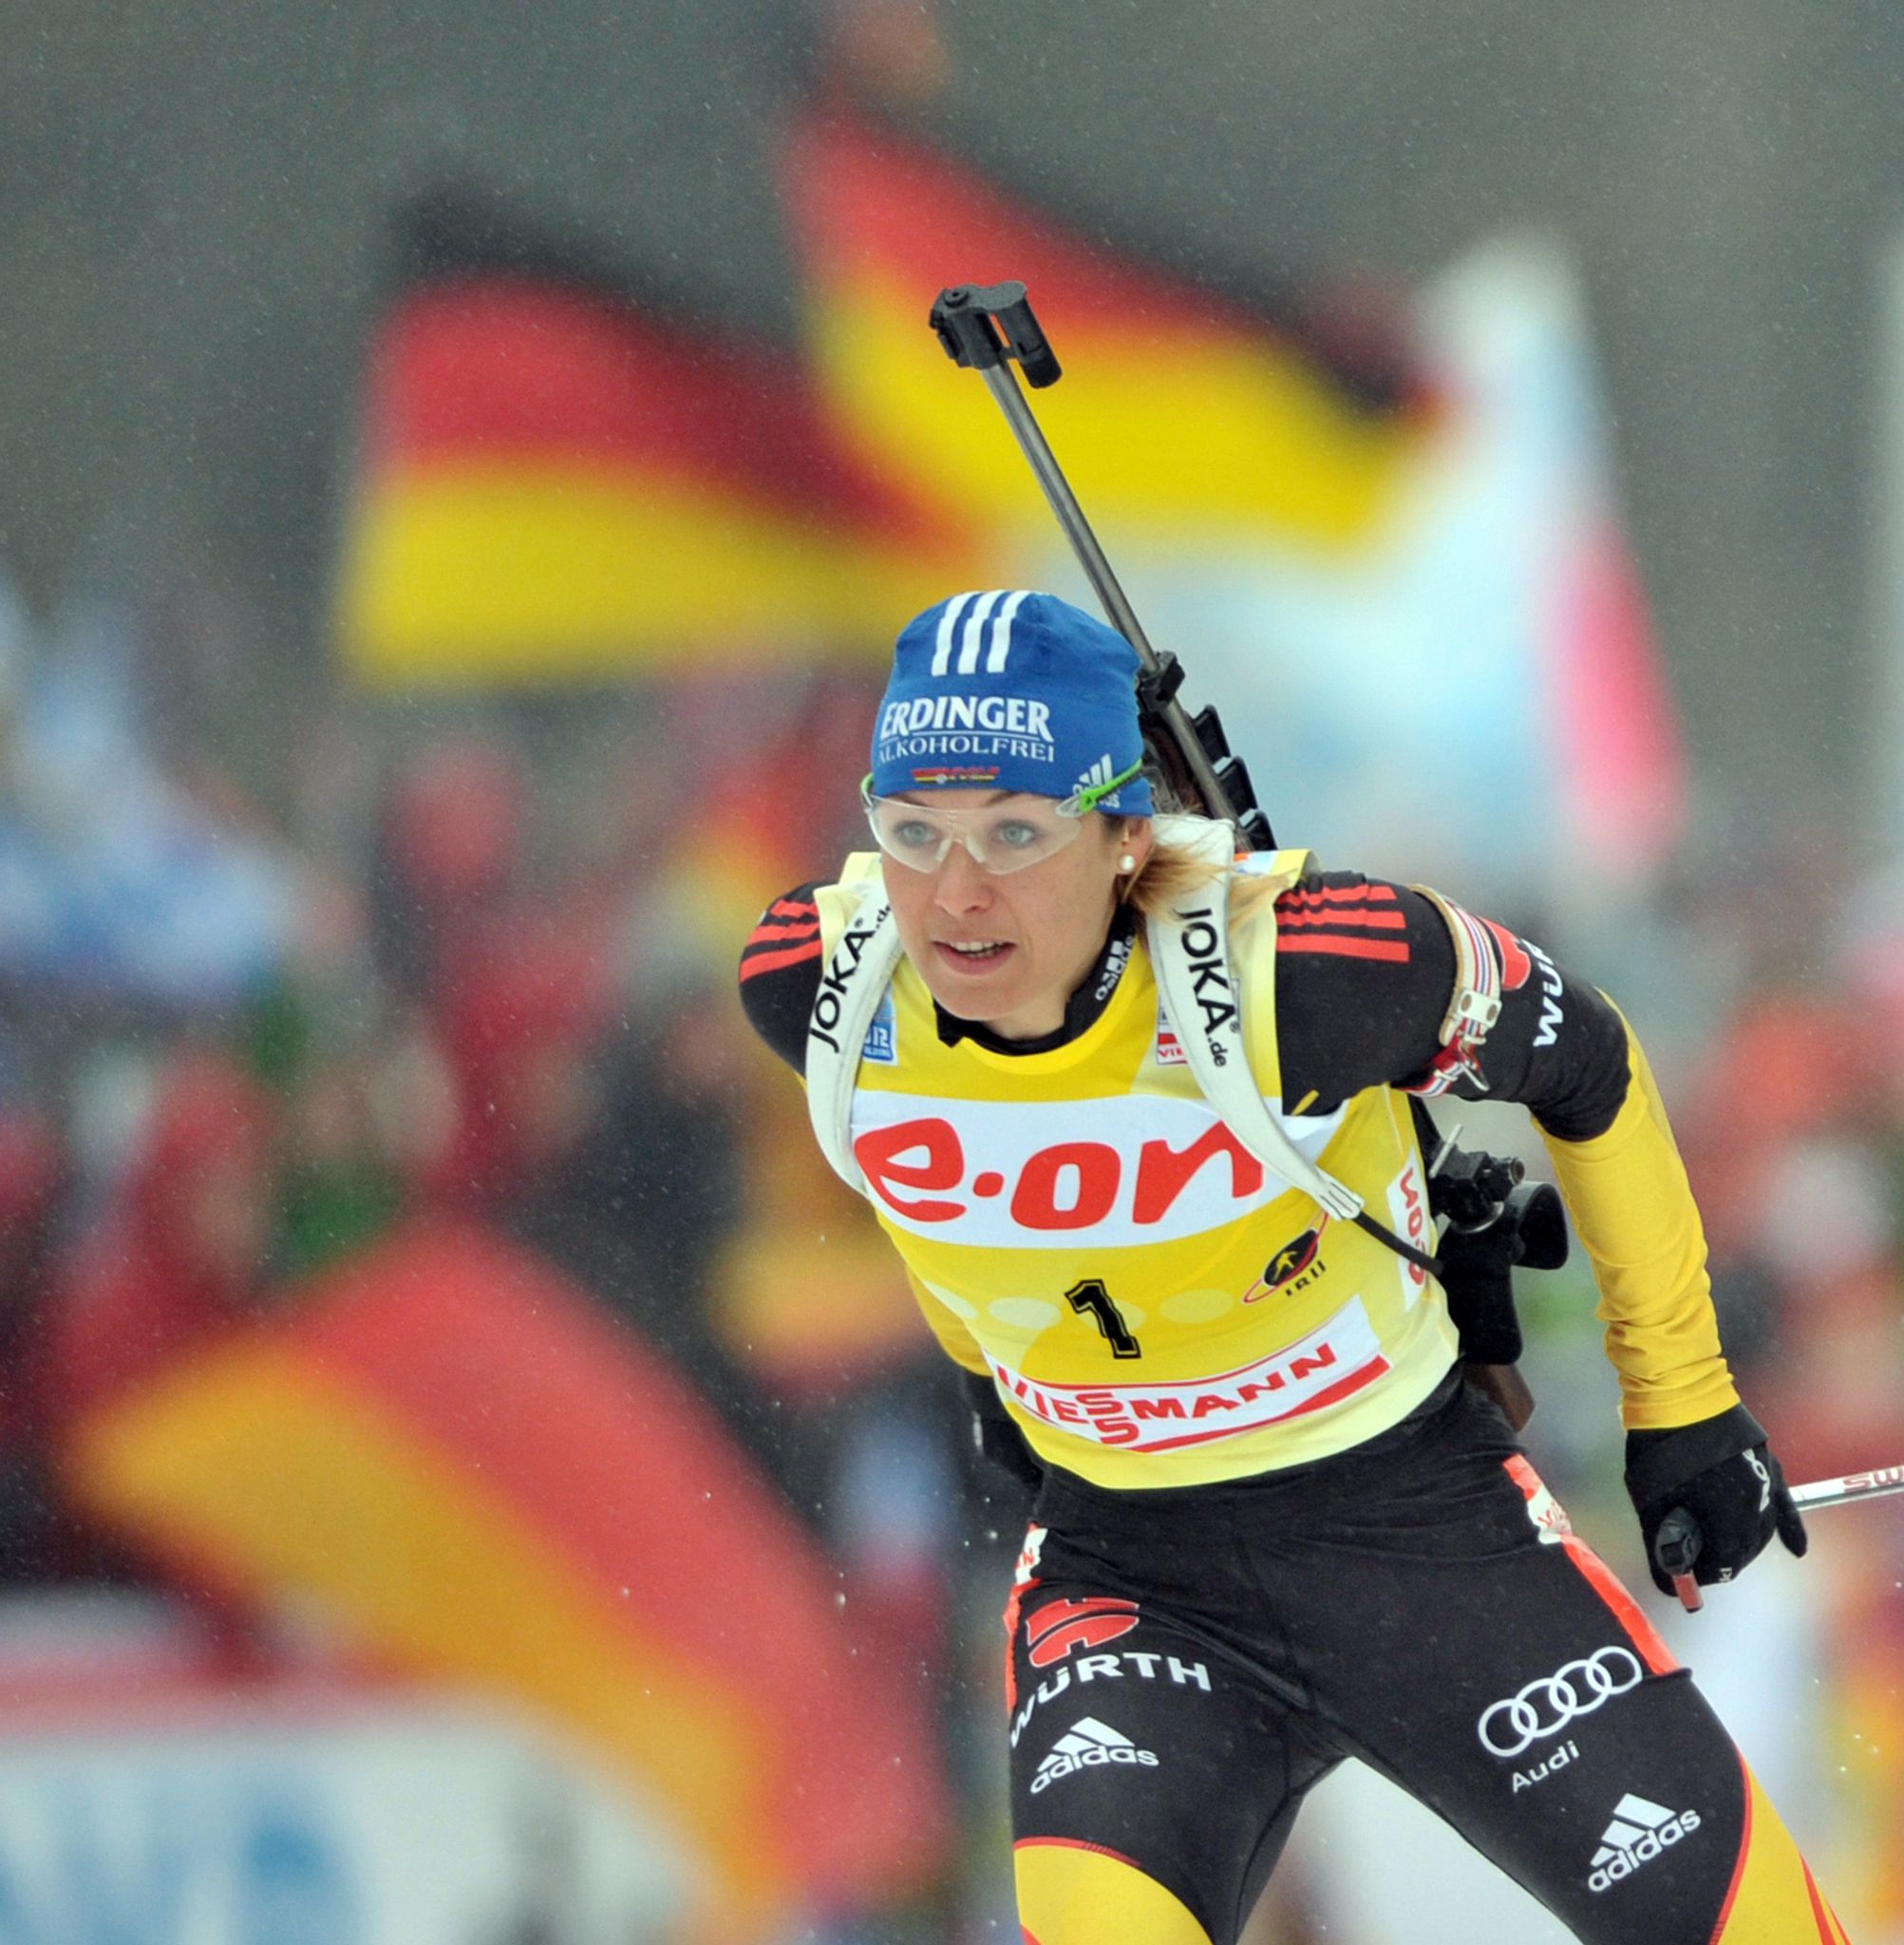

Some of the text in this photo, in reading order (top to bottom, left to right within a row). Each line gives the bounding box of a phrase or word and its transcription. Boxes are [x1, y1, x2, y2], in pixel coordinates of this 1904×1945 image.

[879, 695, 1054, 743] ERDINGER
[878, 735, 1055, 763] ALKOHOLFREI
[1065, 1278, 1142, 1360] 1
[1029, 1745, 1160, 1794] adidas
[1511, 1739, 1581, 1793] Audi
[1587, 1808, 1702, 1893] adidas
